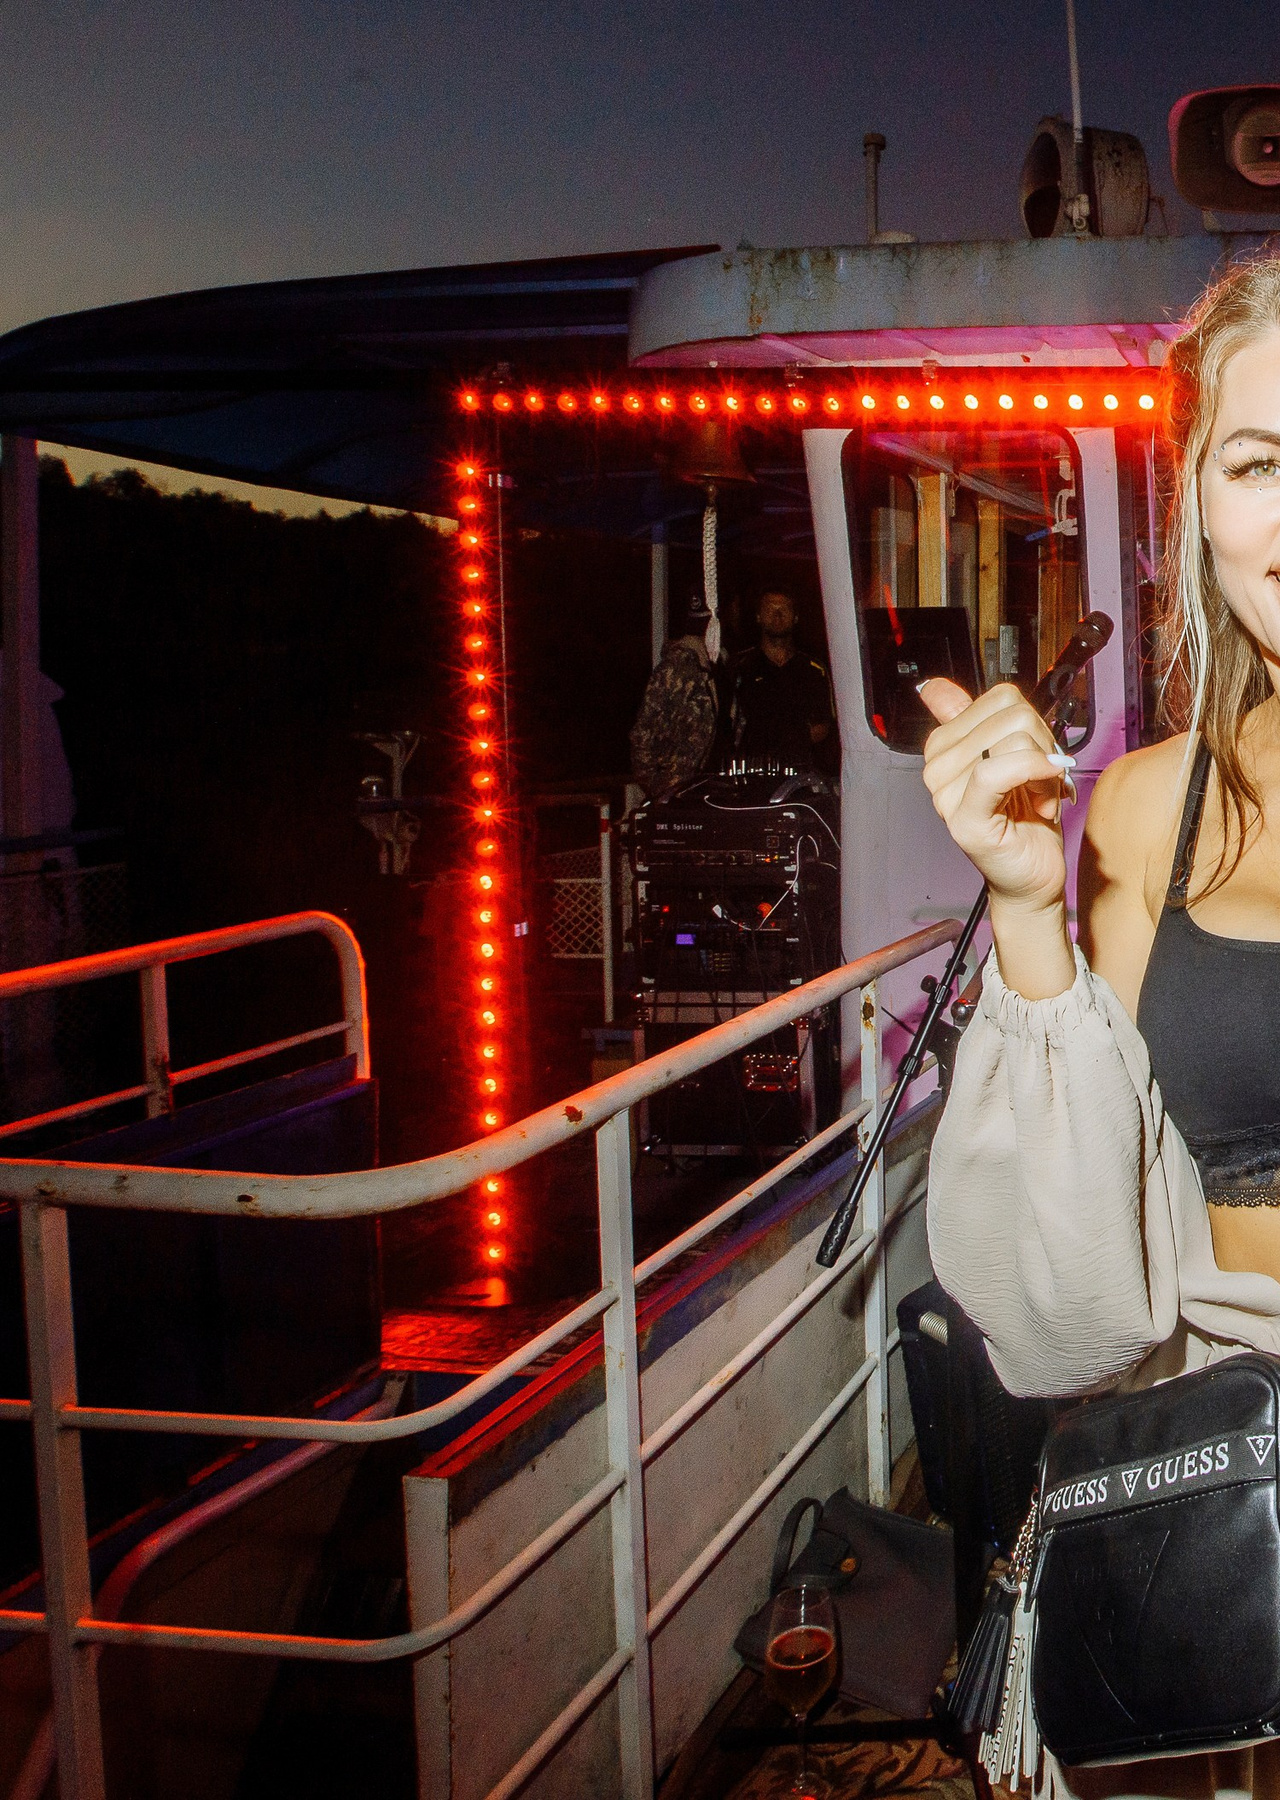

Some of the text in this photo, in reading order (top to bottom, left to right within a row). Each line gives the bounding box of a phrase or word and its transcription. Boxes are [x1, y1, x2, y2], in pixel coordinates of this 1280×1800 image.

[673, 823, 703, 831] Splitter
[1053, 1442, 1230, 1512] GUESS GUESS
